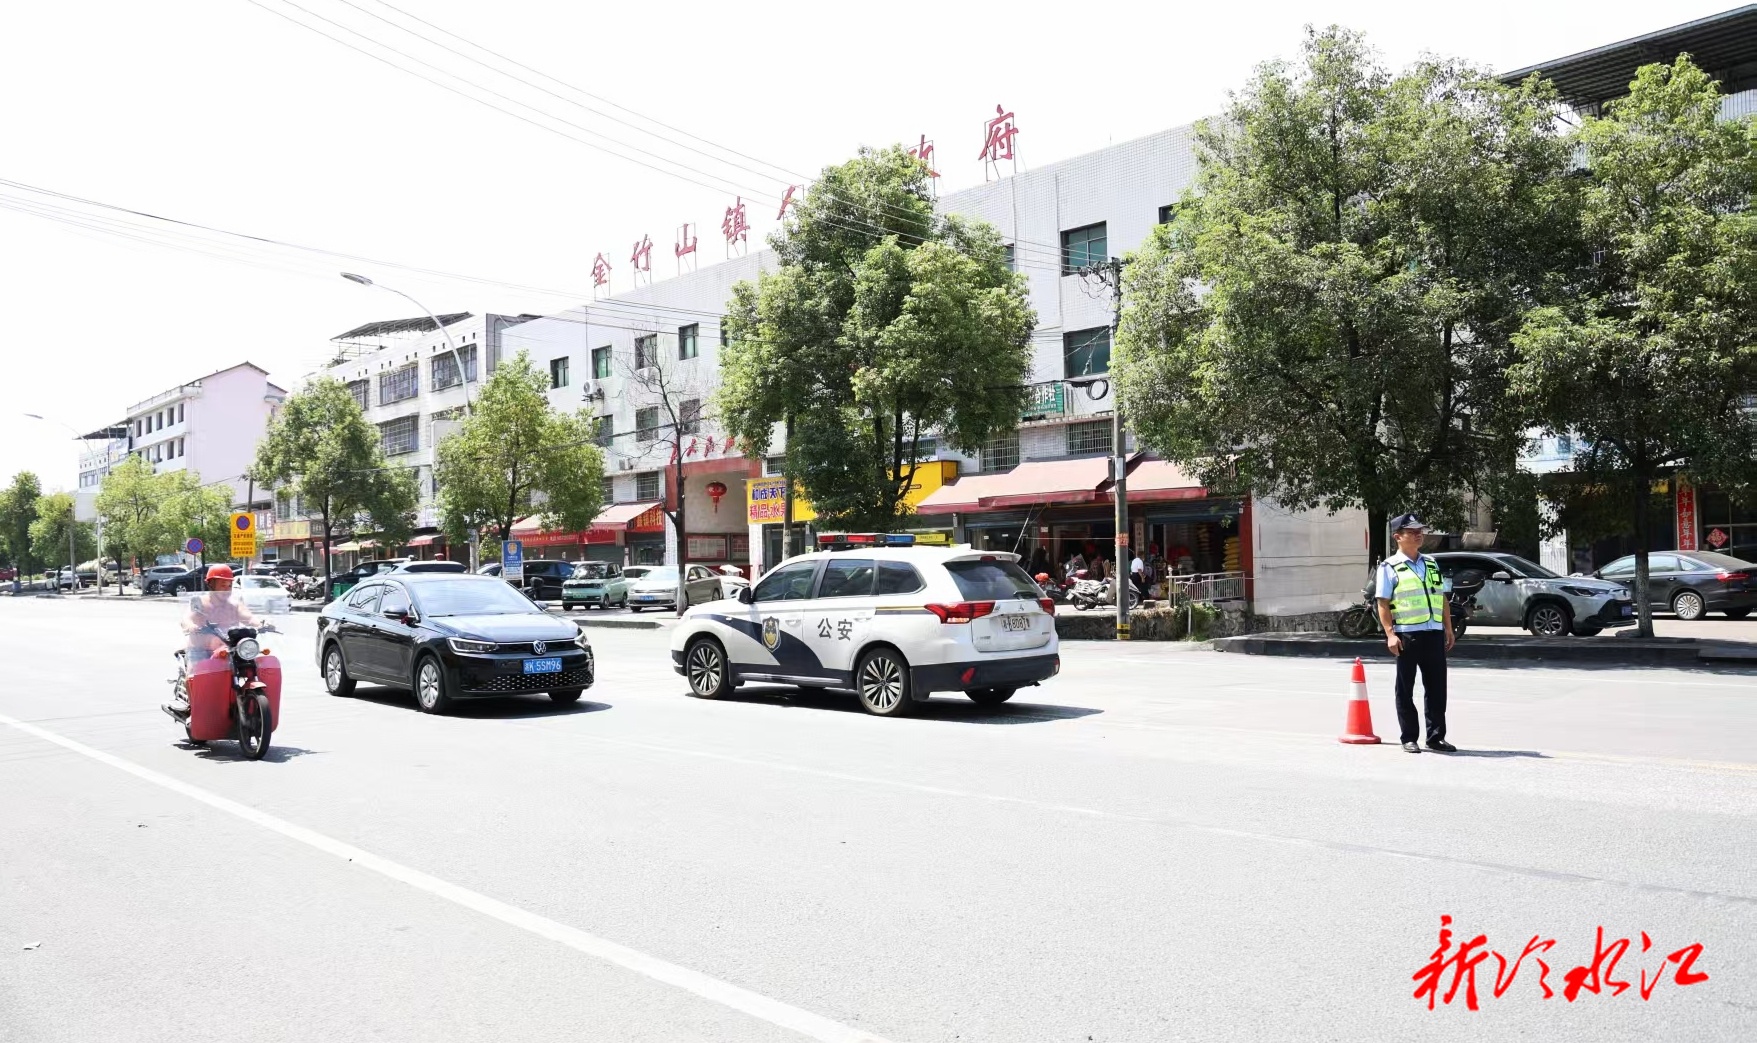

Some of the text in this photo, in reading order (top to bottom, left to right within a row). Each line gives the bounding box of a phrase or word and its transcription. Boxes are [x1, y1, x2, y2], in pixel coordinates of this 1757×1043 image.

[590, 104, 1018, 286] 金竹山镇府
[1034, 384, 1056, 405] 合作社
[817, 617, 853, 641] 公安
